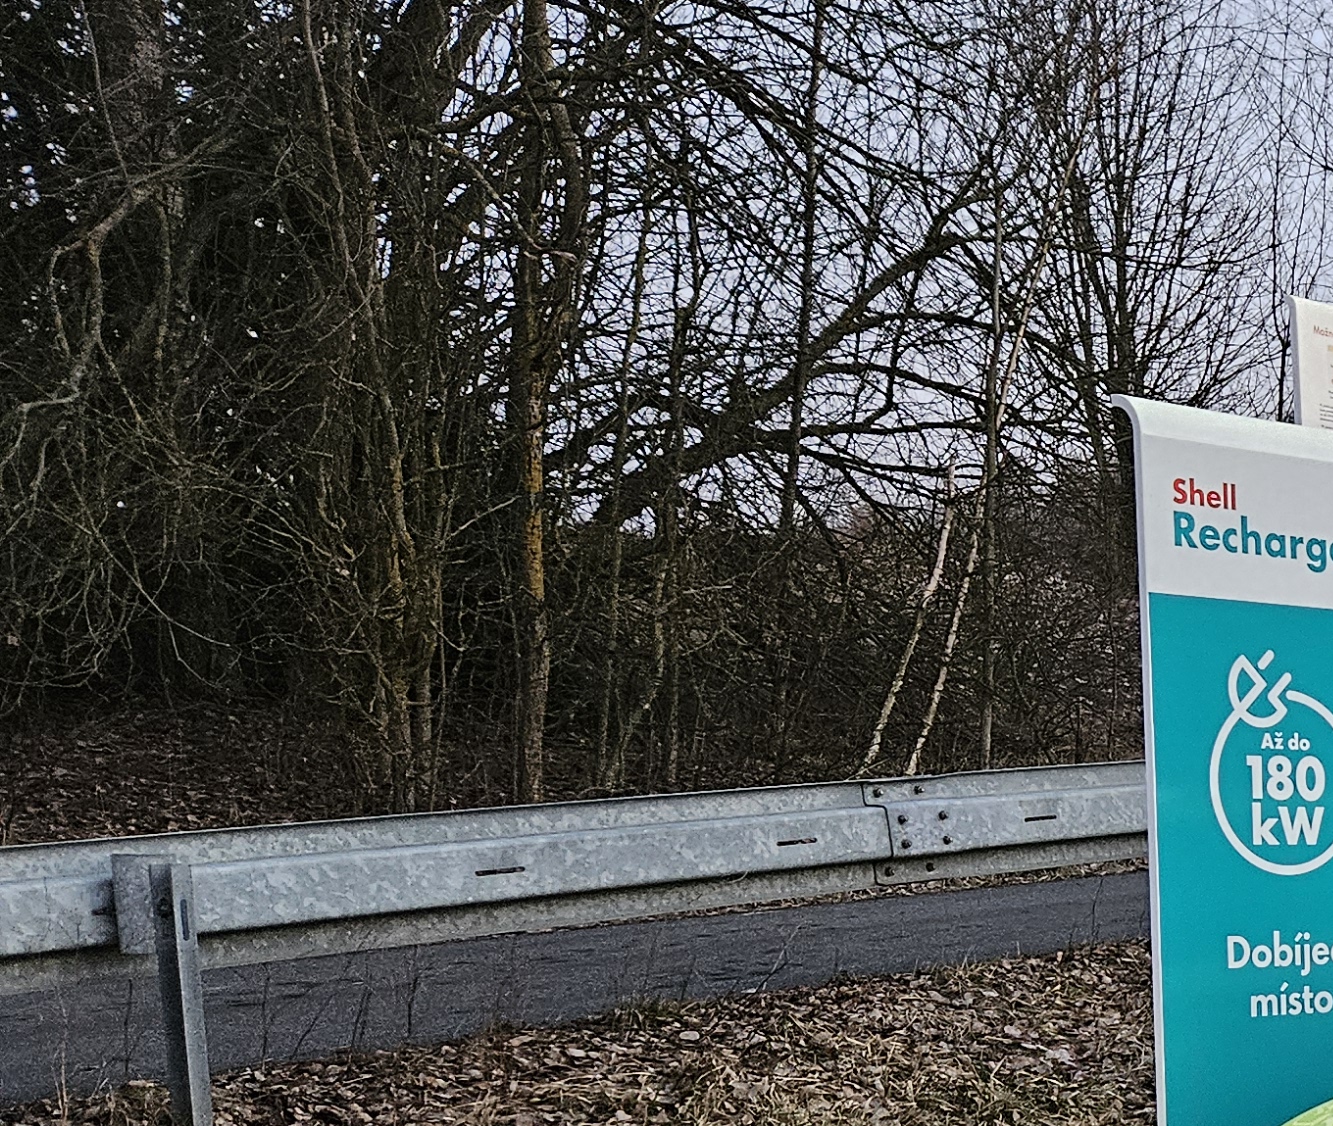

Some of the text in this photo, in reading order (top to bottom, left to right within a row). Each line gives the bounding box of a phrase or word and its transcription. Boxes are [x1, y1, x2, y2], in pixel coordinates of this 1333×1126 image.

[1173, 478, 1236, 511] Shell
[1260, 731, 1310, 751] Až do
[1246, 755, 1326, 801] 180
[1252, 802, 1325, 847] kW
[1250, 982, 1333, 1017] místo
